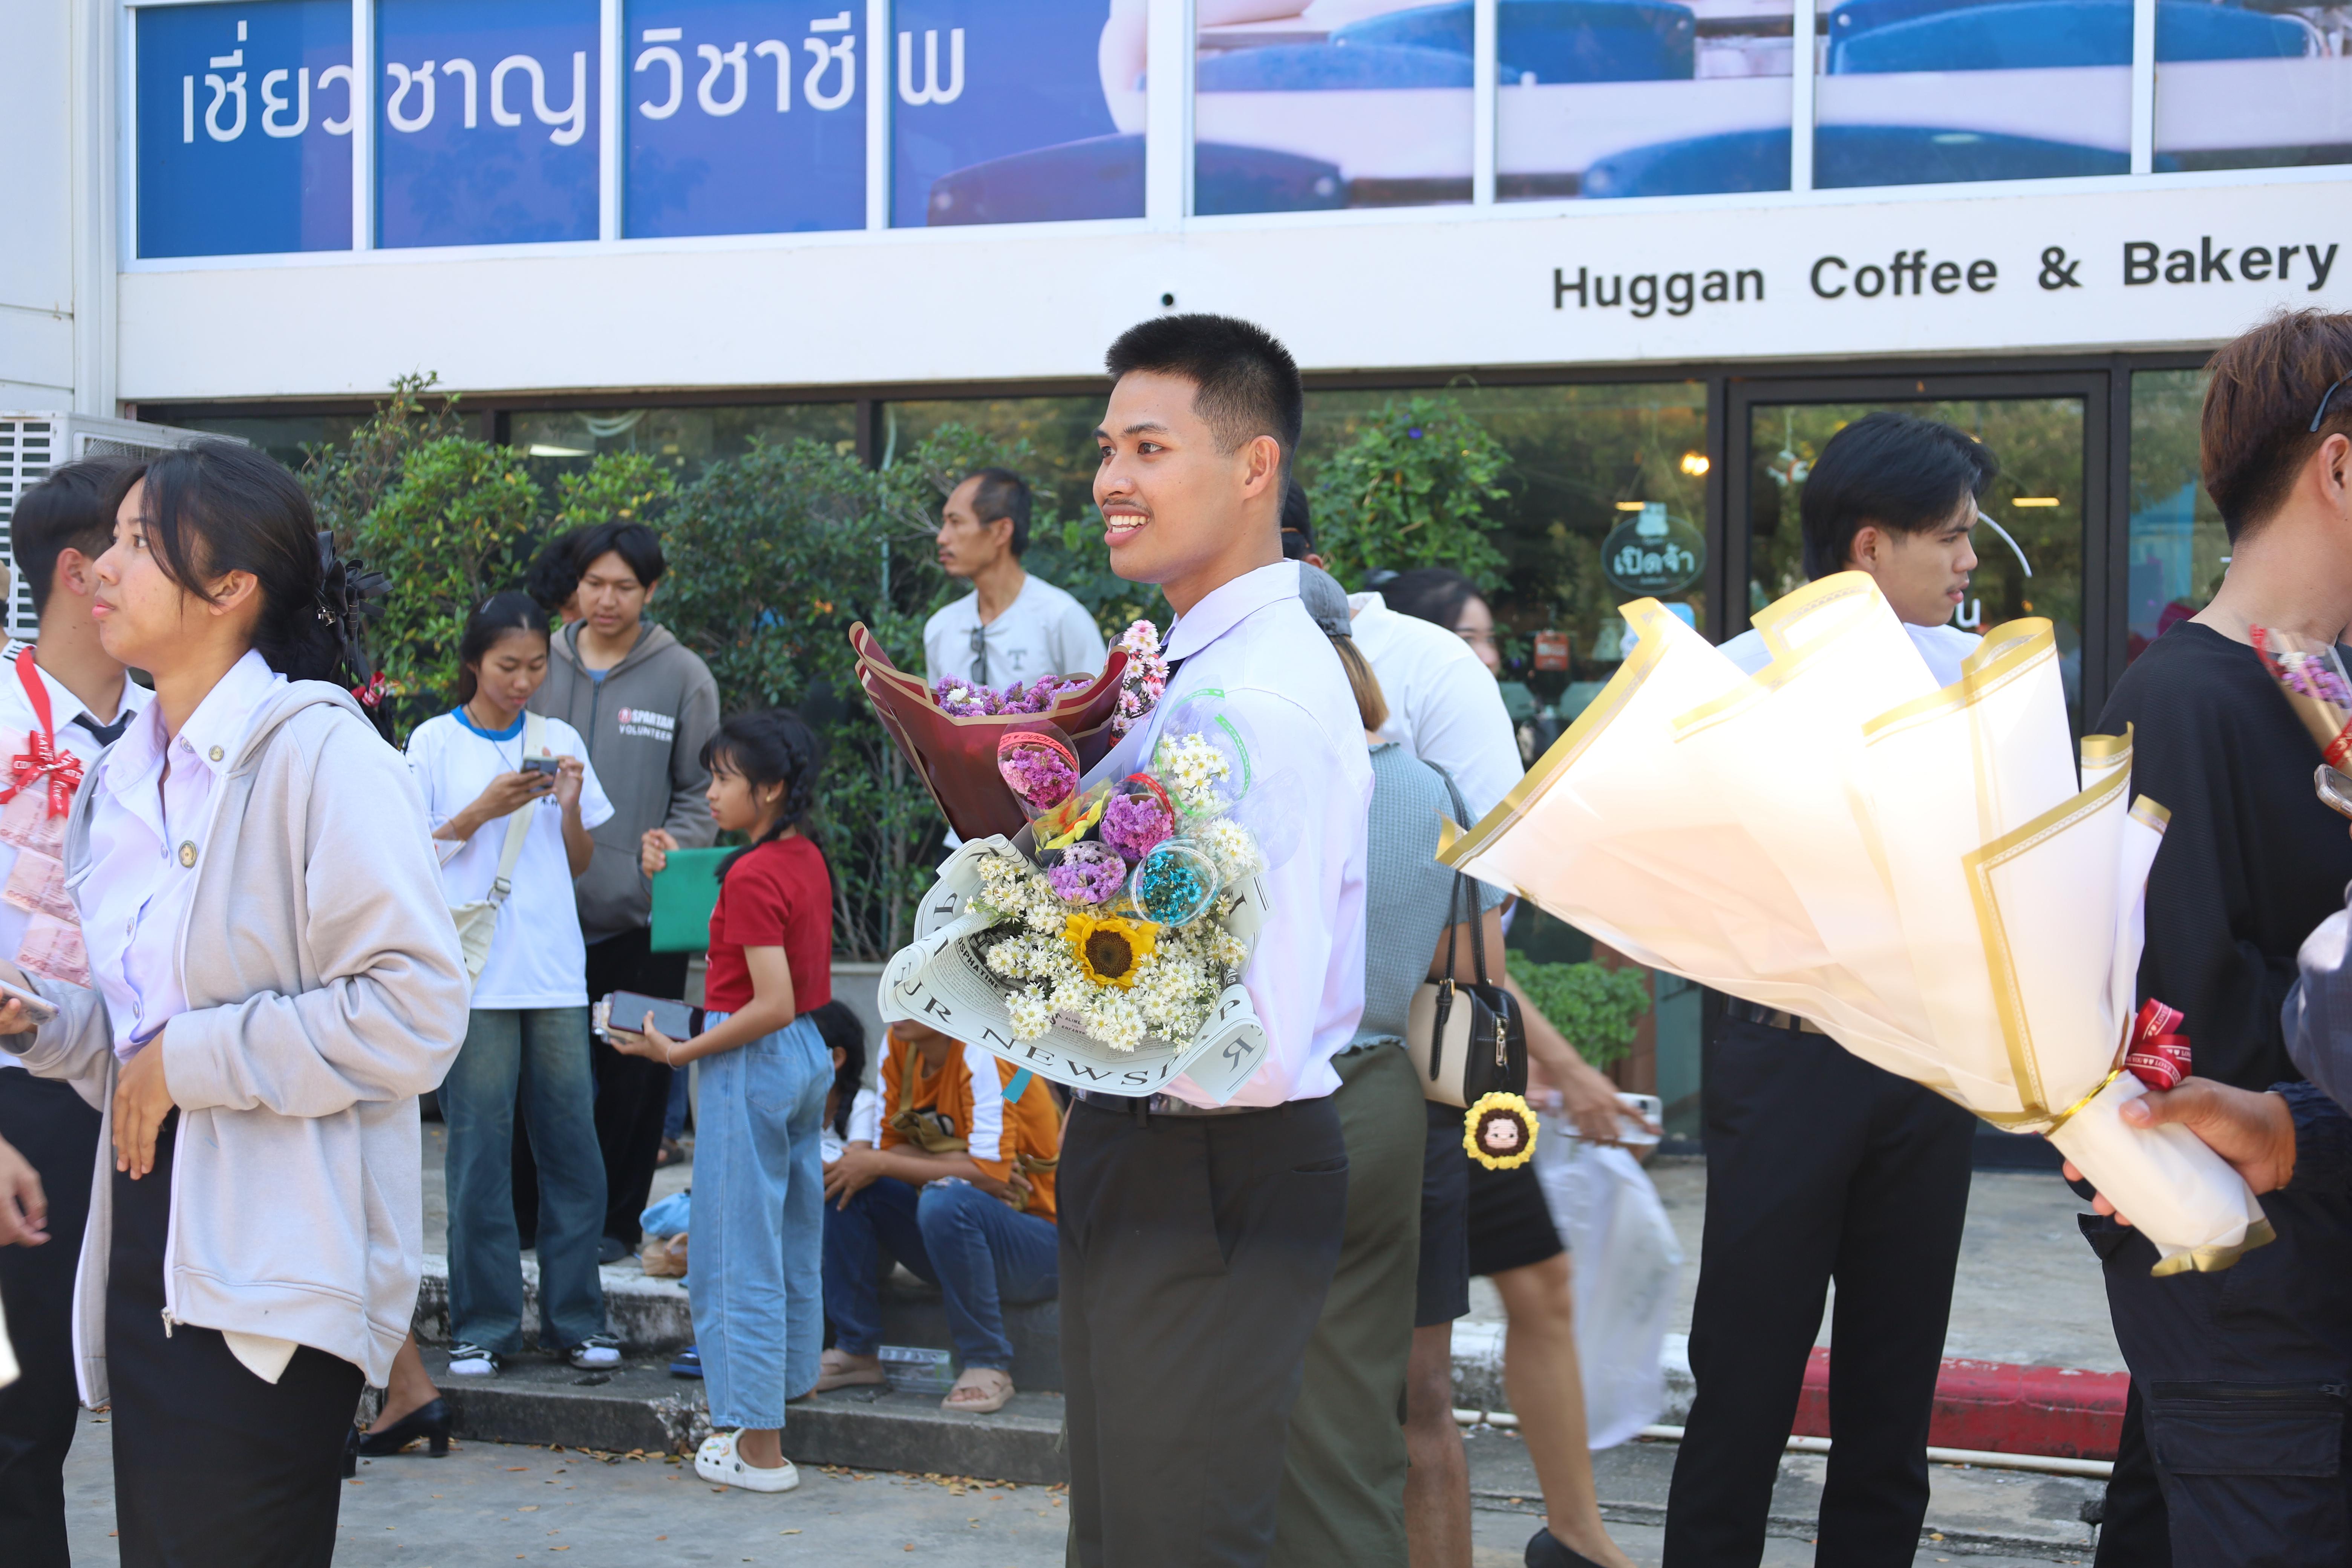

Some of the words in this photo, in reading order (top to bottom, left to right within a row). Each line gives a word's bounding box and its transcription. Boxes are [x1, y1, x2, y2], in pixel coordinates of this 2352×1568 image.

[1554, 267, 1764, 318] Huggan
[1810, 250, 1997, 299] Coffee
[2038, 246, 2081, 291] &
[2124, 236, 2339, 292] Bakery
[1614, 542, 1695, 576] เปิดจ้า
[632, 709, 675, 729] SPARTAN
[619, 724, 673, 743] VOLUNTEER
[2154, 1061, 2172, 1072] LOVE
